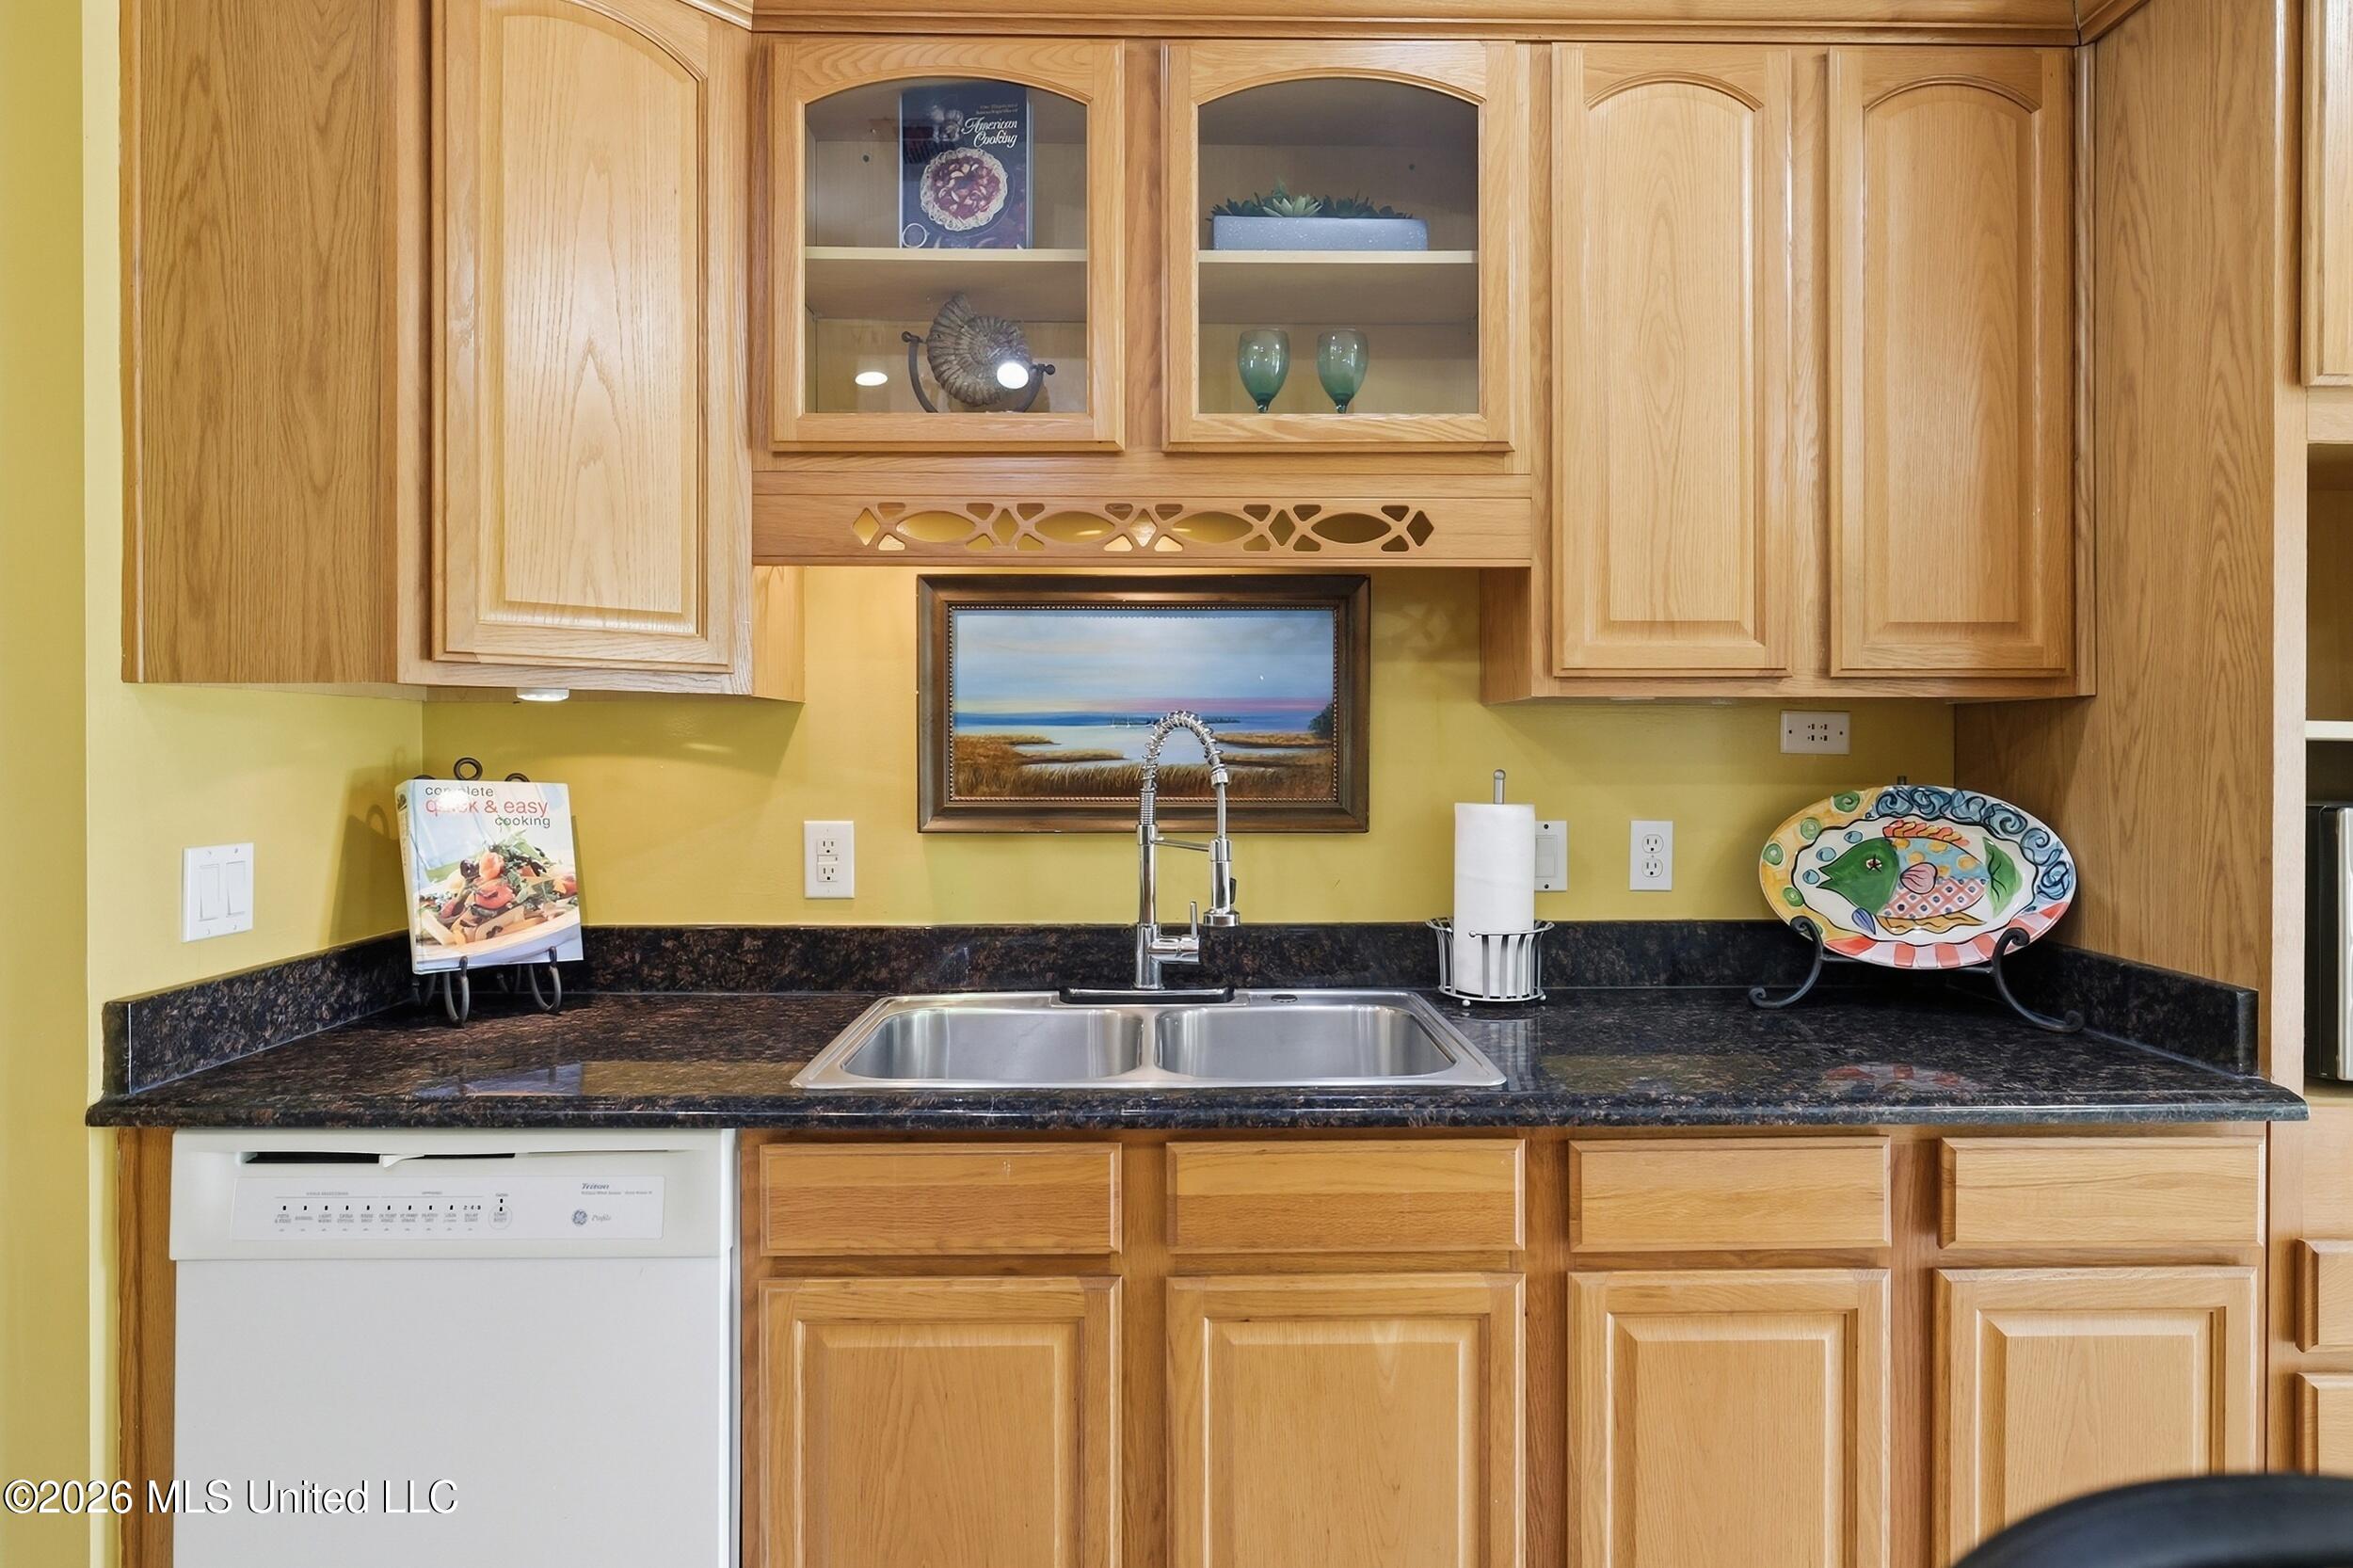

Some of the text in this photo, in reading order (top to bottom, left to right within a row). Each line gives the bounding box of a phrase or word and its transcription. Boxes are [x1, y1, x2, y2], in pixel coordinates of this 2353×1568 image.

[961, 116, 1017, 135] American
[973, 130, 1018, 149] Cooking
[424, 786, 494, 797] colete
[484, 800, 499, 813] &
[504, 800, 548, 818] easy
[495, 815, 551, 828] cooking
